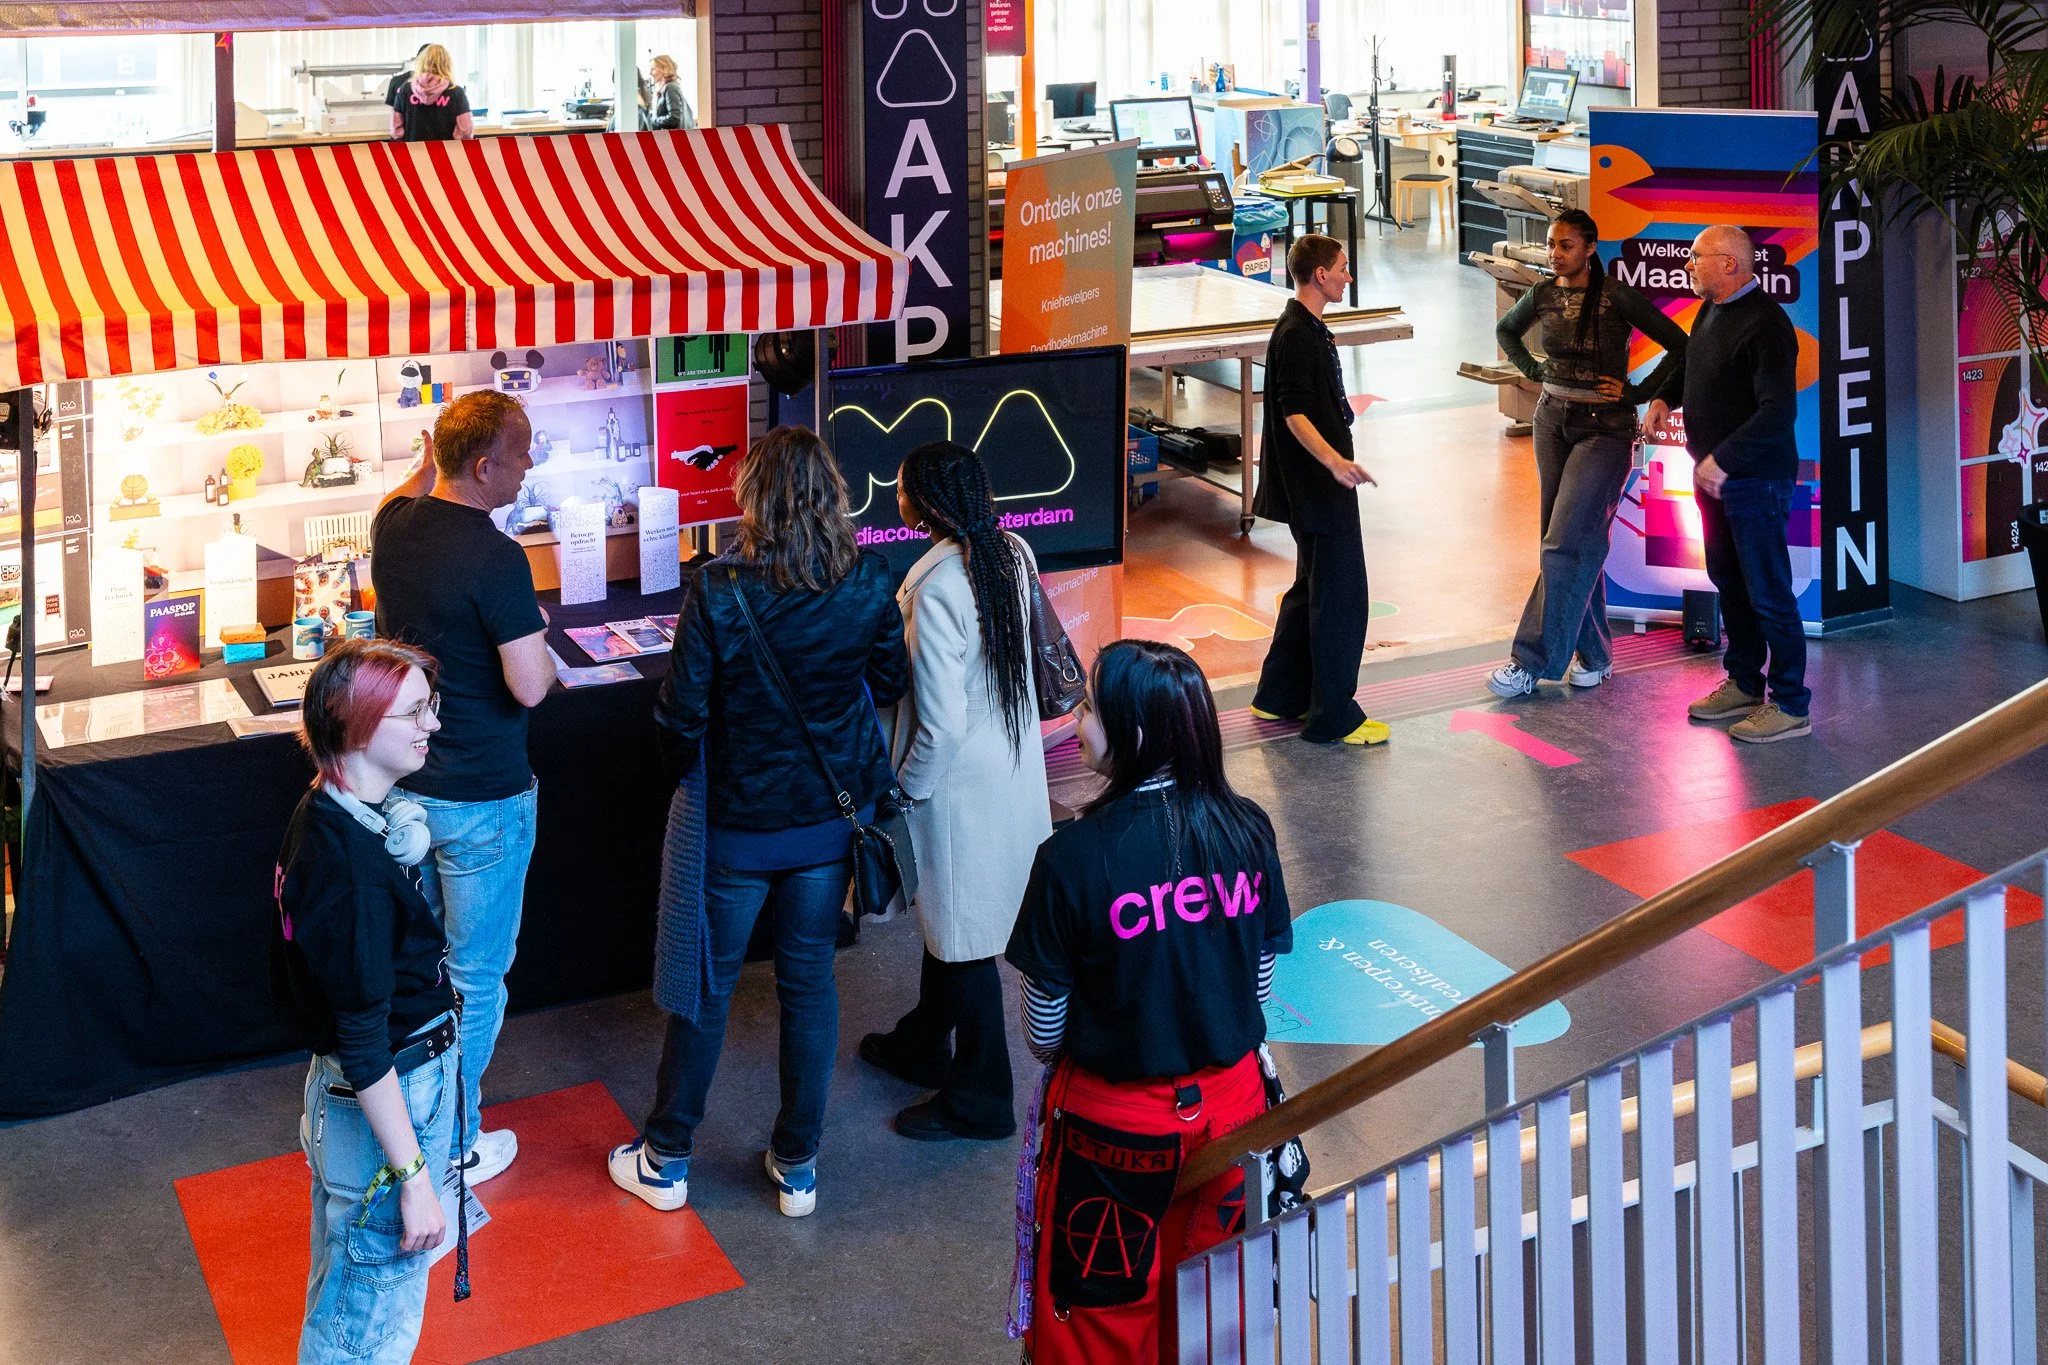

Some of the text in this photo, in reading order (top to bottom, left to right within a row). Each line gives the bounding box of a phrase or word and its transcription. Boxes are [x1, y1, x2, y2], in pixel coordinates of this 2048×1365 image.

[1020, 186, 1122, 227] Ontdek onze
[1029, 221, 1112, 265] machines!
[1638, 242, 1692, 258] Welko
[1244, 263, 1269, 272] PAPIER
[1041, 286, 1101, 314] Kniehevelpers
[1962, 368, 1984, 382] 1423
[2034, 462, 2048, 473] 142
[996, 507, 1074, 530] sterdam
[643, 535, 658, 543] echte
[645, 528, 665, 536] Werken
[2011, 520, 2019, 549] 1424
[1046, 567, 1099, 599] ackmachine
[150, 602, 195, 618] PAASPOP
[1062, 611, 1090, 632] achine
[1109, 871, 1262, 940] crew
[1319, 937, 1345, 951] &
[1342, 950, 1445, 1021] ntwerpen
